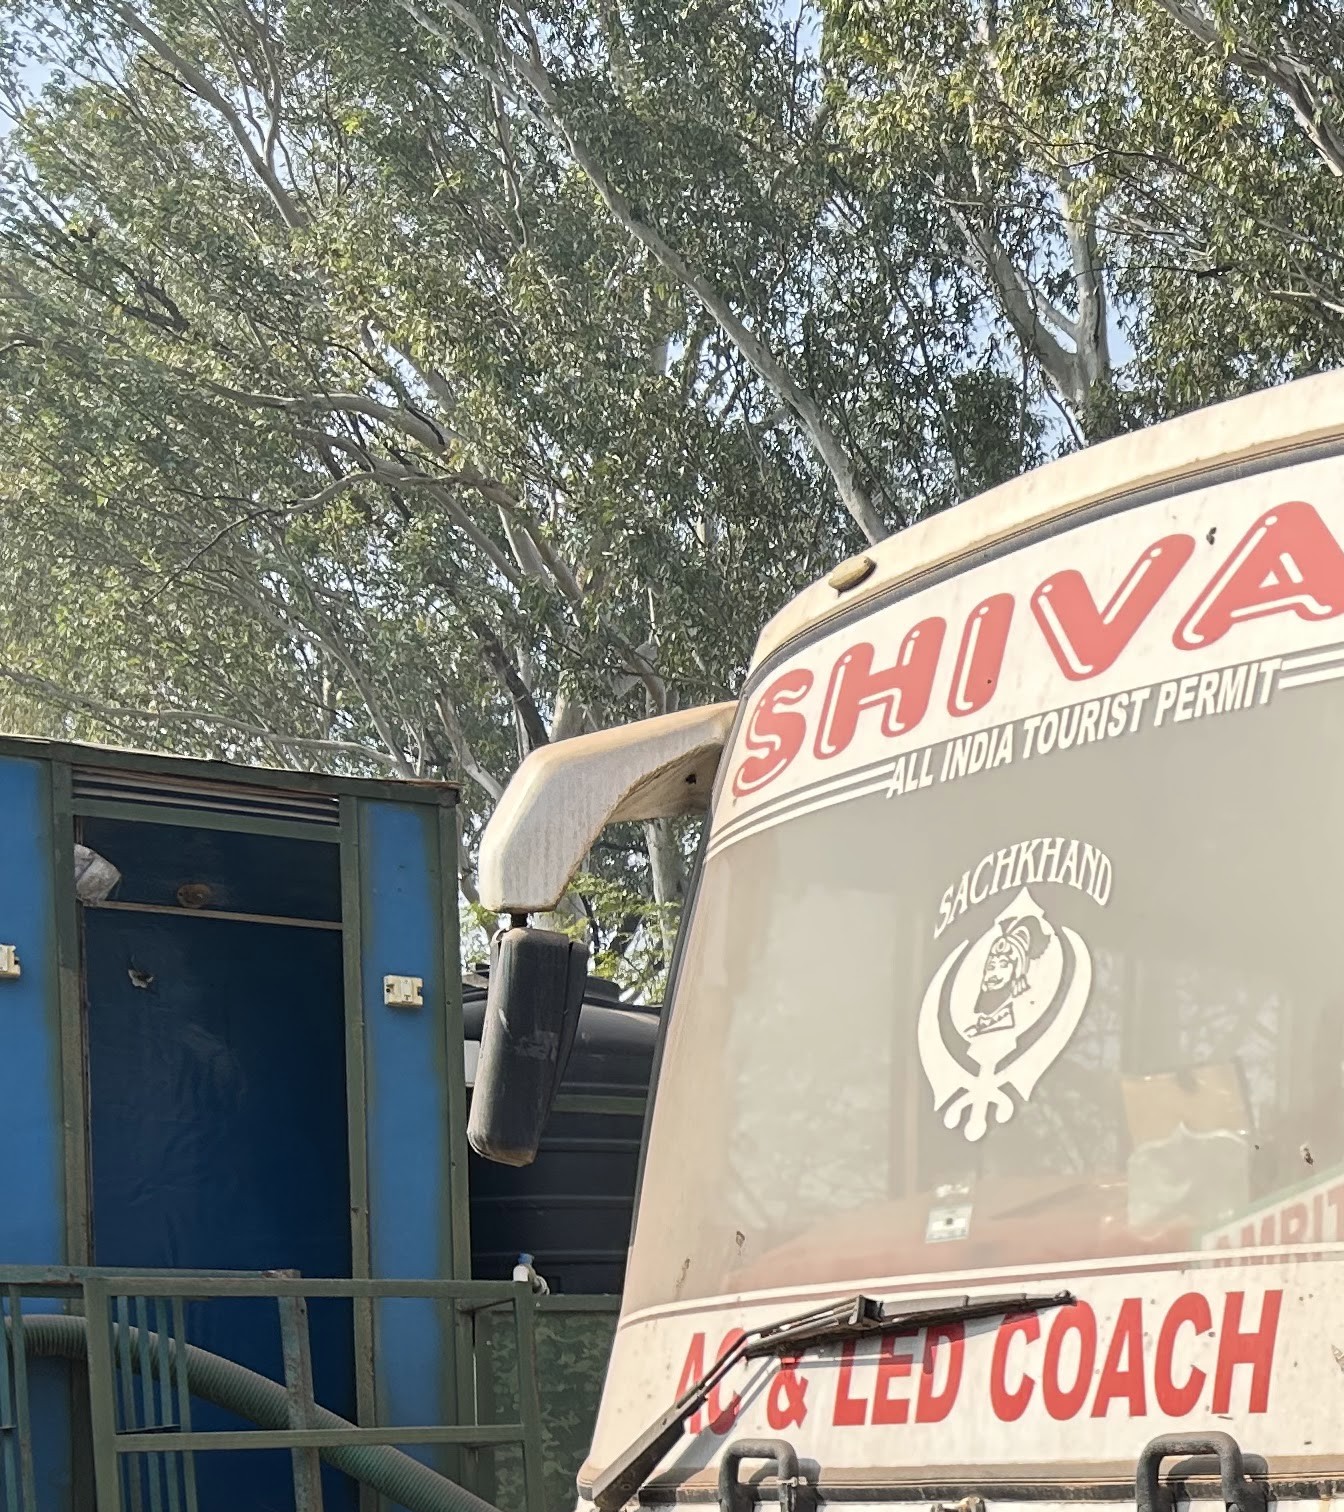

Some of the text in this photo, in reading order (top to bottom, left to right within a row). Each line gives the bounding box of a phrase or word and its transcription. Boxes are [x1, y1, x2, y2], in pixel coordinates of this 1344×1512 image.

[886, 657, 1283, 799] ALL INDIA TOURIST PERMIT
[933, 837, 1113, 939] SACHKHAND
[832, 1320, 966, 1427] LED
[989, 1289, 1284, 1421] COACH
